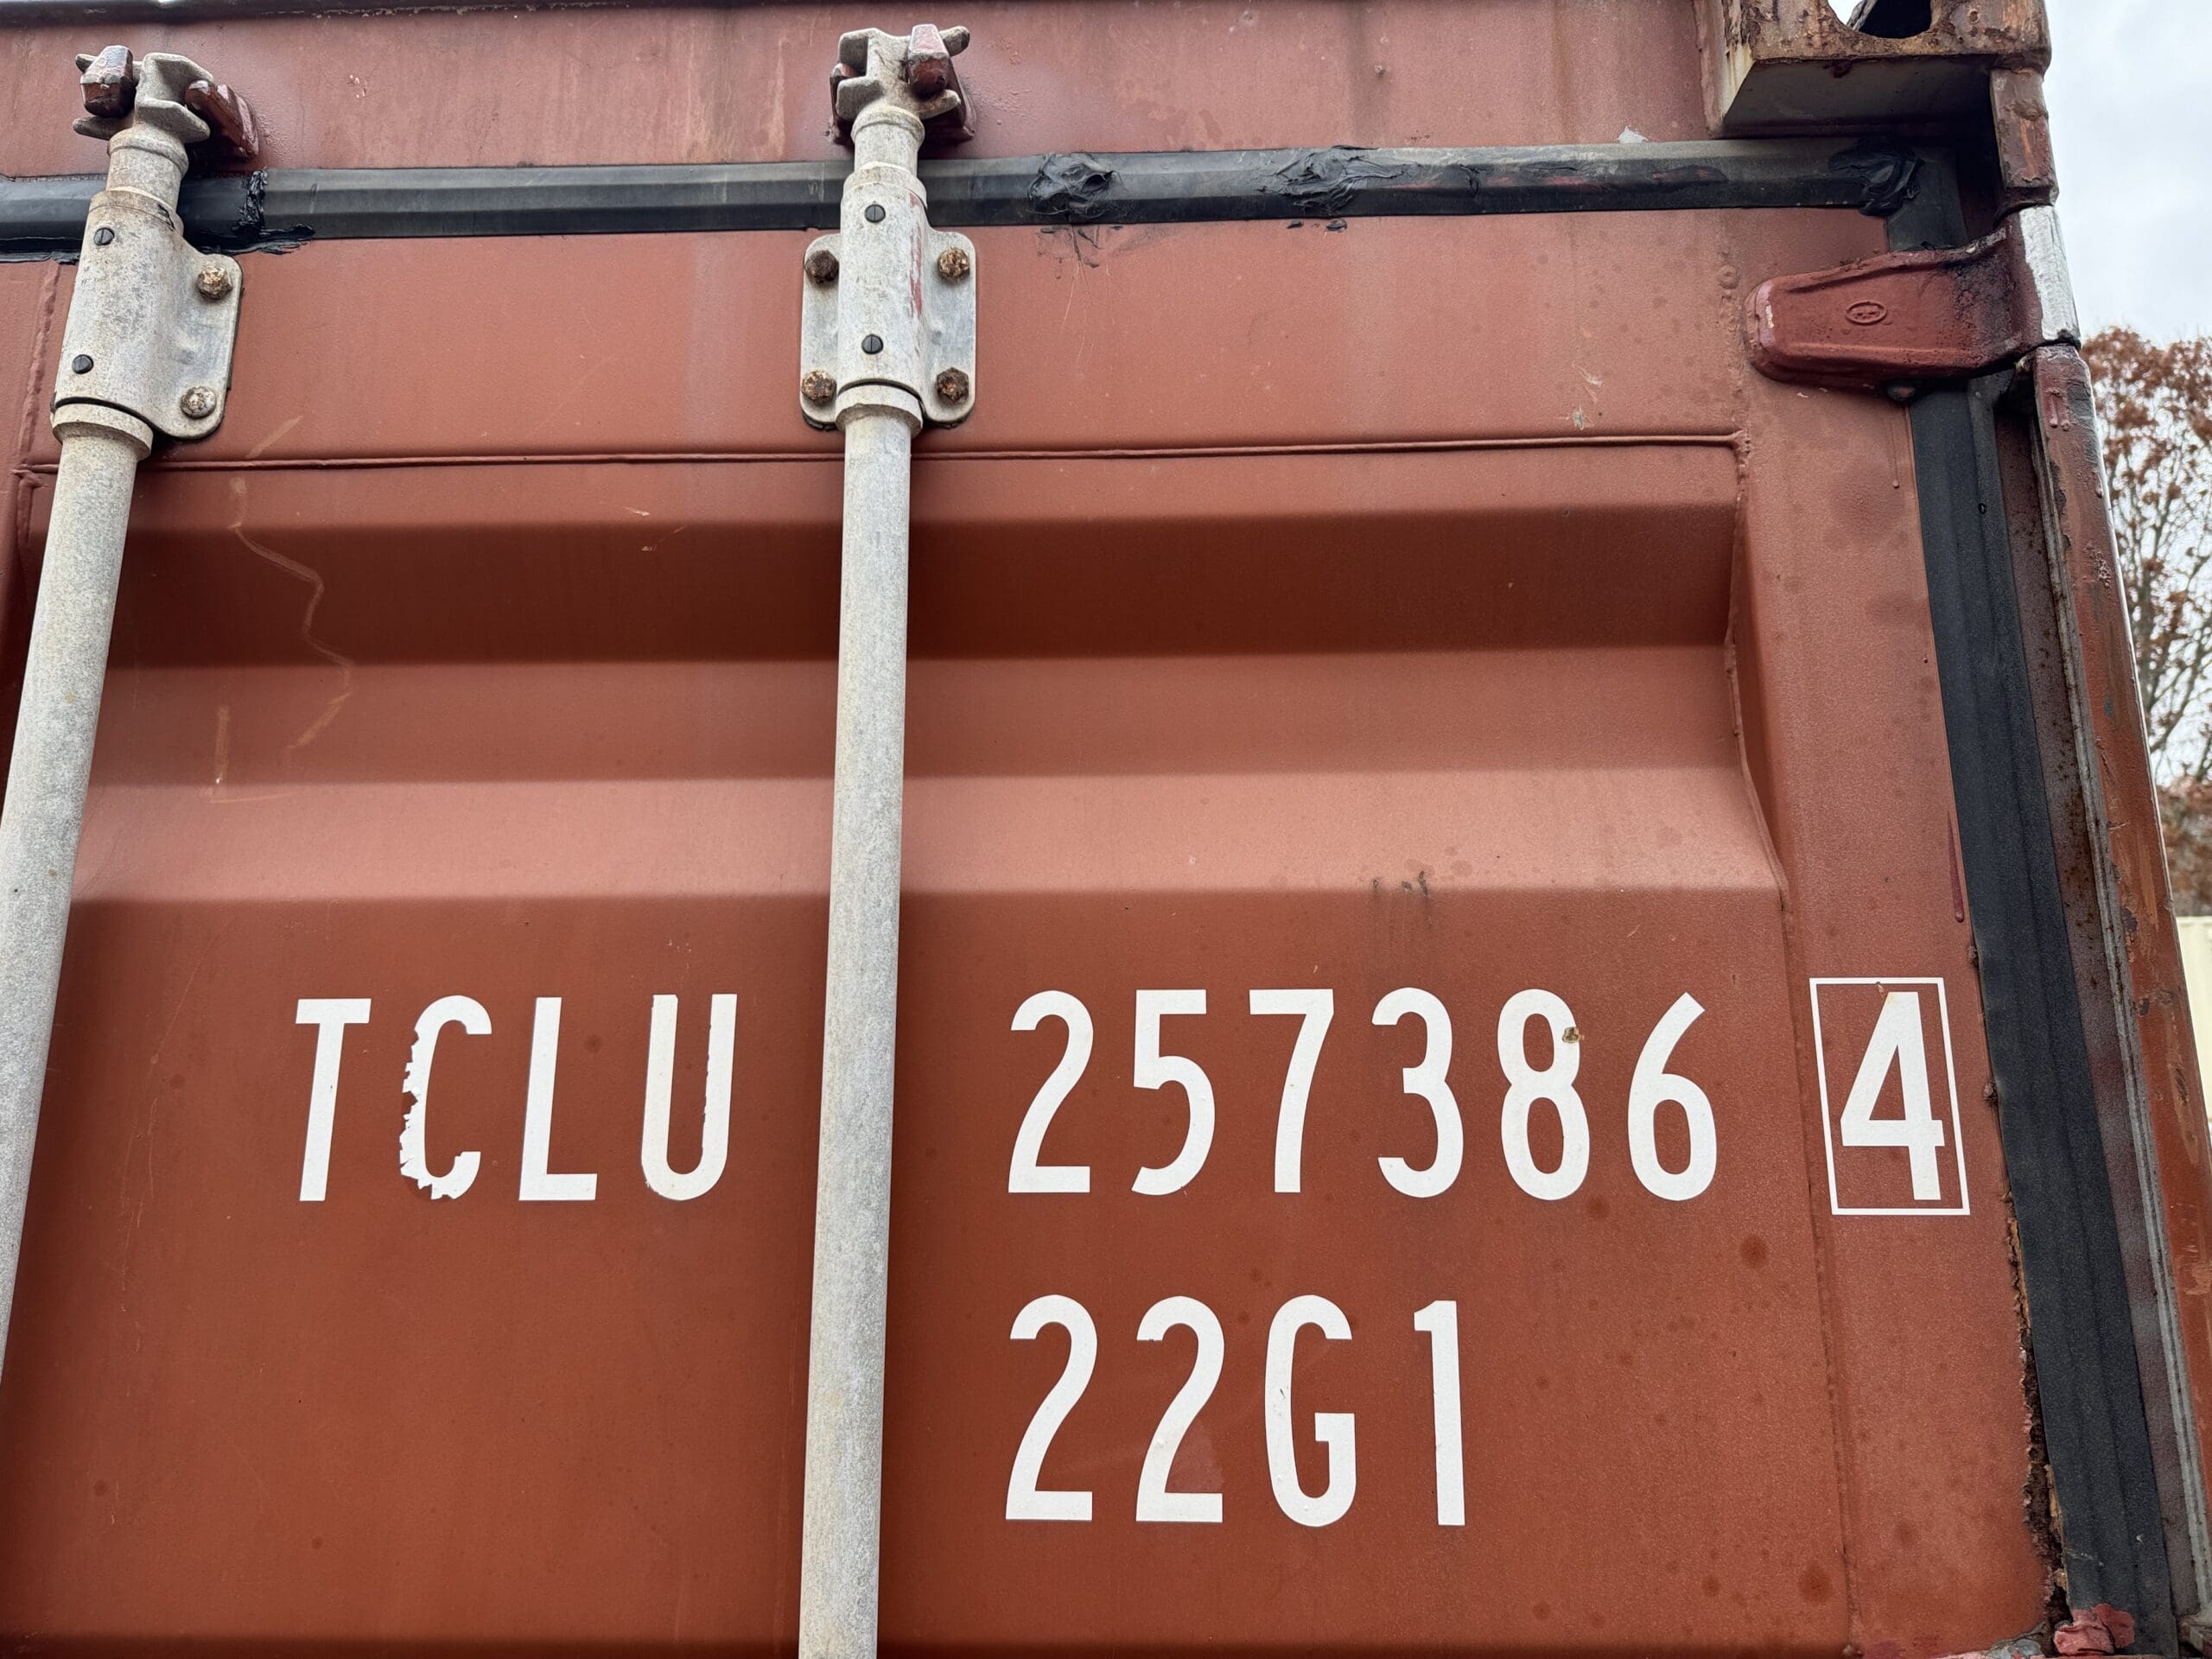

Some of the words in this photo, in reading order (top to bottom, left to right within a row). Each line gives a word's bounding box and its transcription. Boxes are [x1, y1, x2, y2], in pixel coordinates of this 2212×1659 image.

[296, 994, 737, 1201] TCLU
[1008, 988, 1717, 1201] 257386
[1840, 992, 1944, 1200] 4
[1006, 1294, 1465, 1527] 22G1
